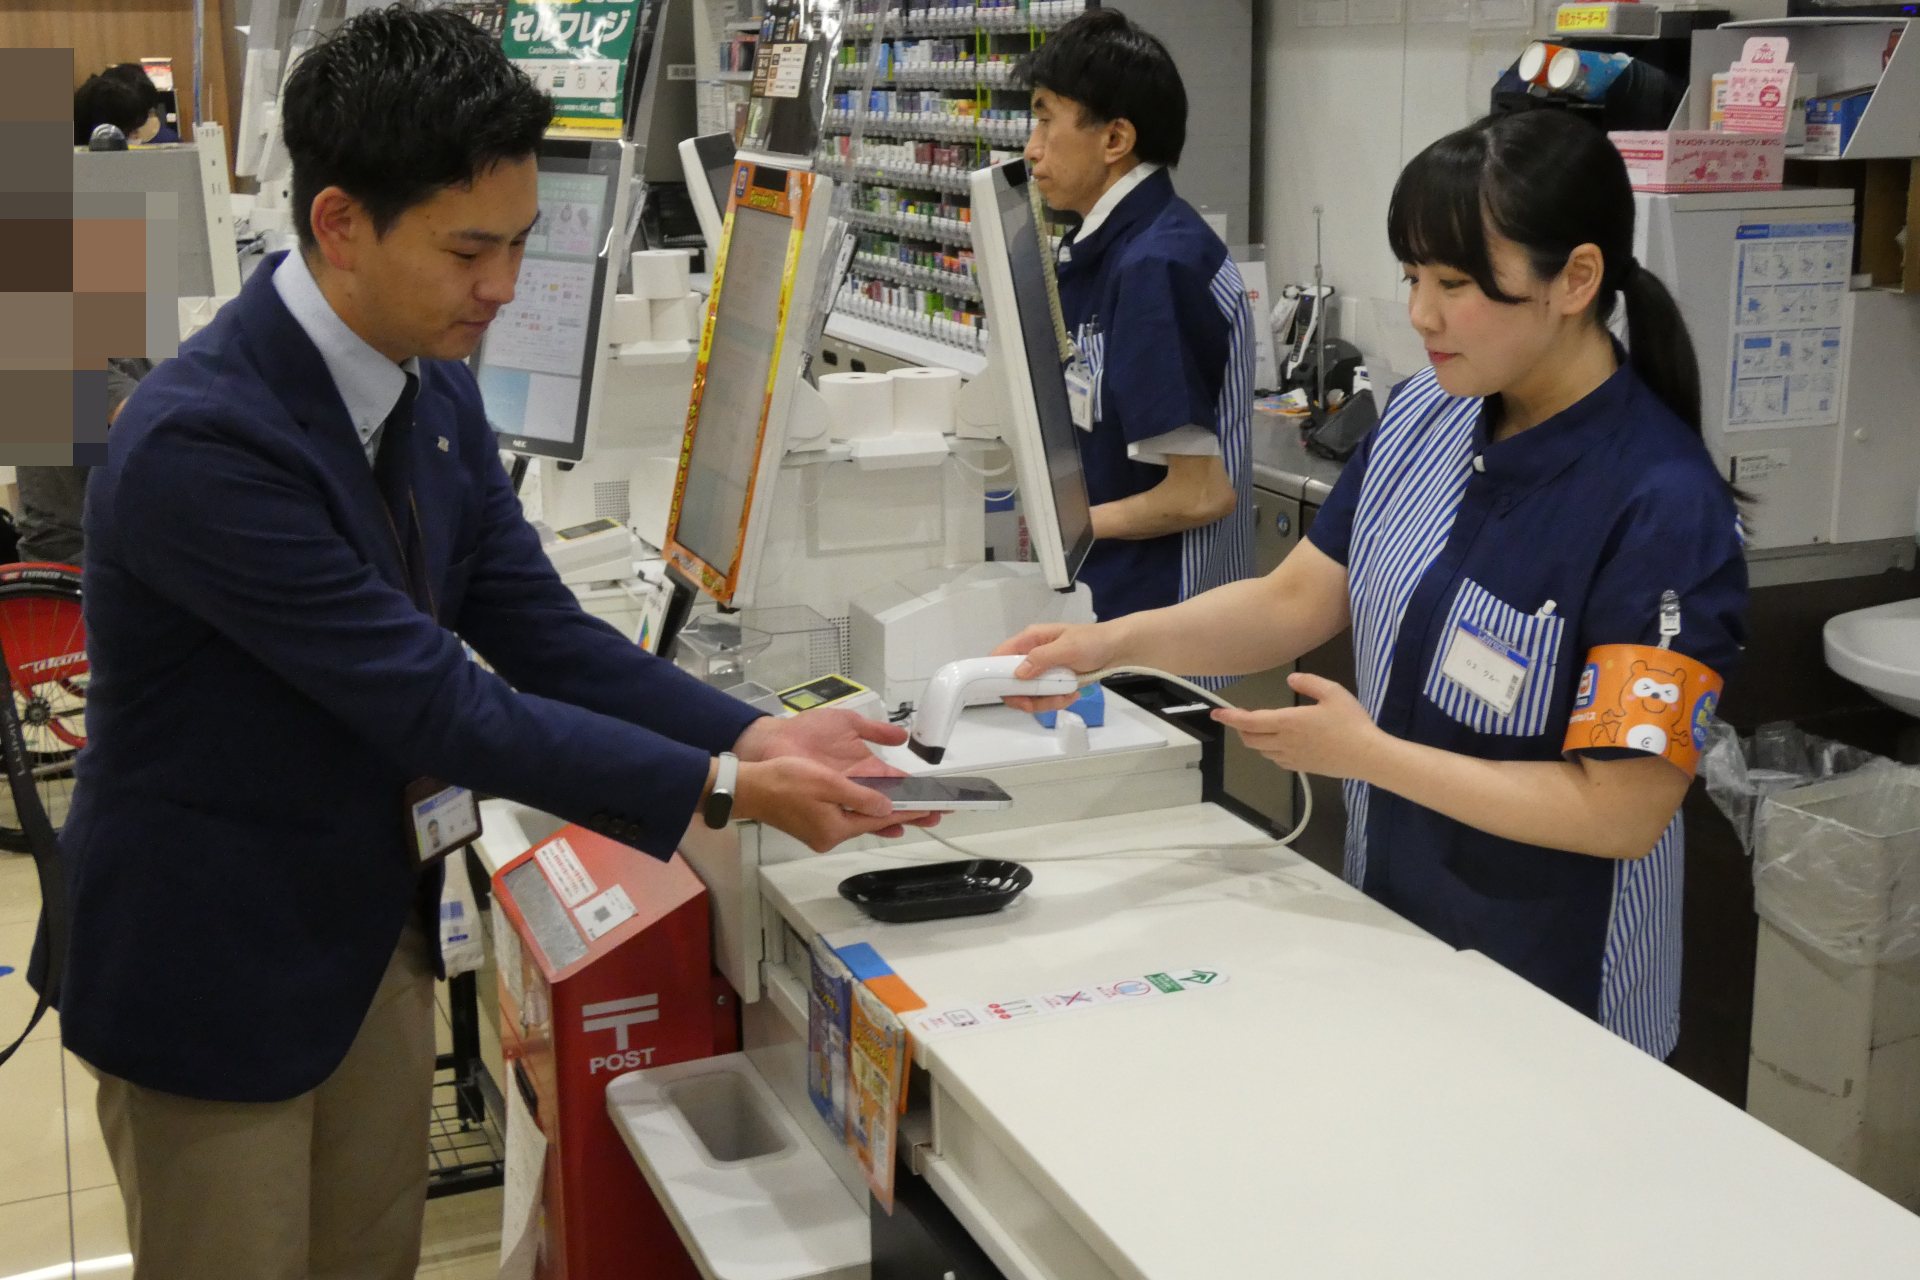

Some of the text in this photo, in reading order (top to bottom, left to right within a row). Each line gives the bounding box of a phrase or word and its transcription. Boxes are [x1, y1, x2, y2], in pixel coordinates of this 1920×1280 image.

[510, 10, 631, 42] セルフレジ
[590, 1047, 656, 1074] POST
